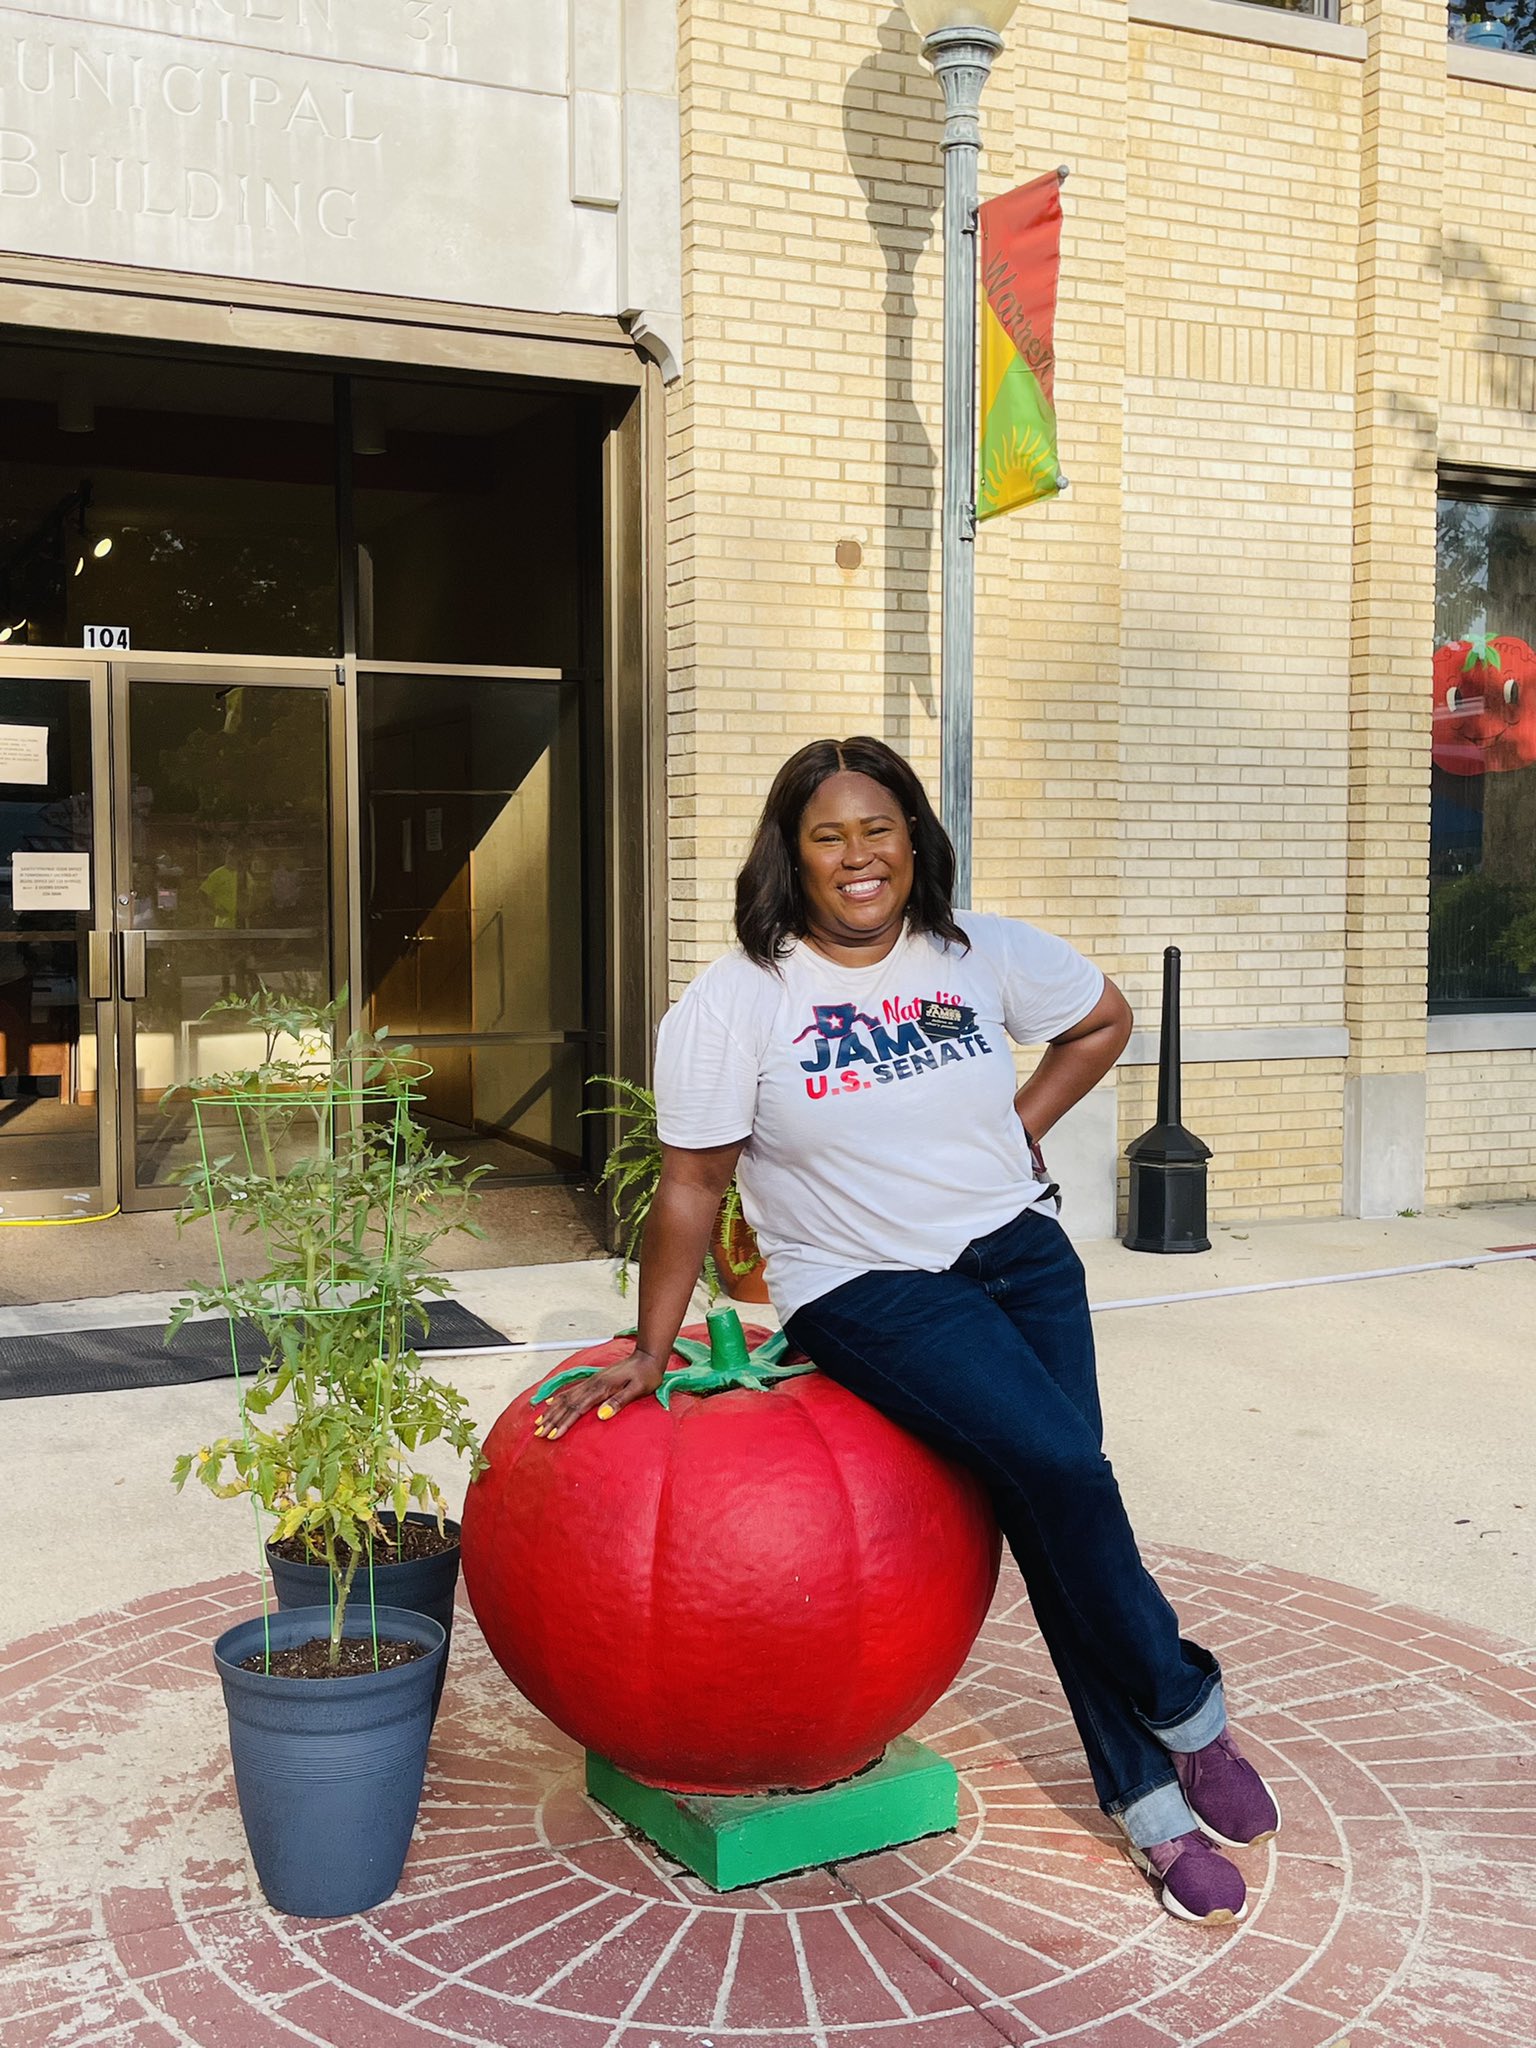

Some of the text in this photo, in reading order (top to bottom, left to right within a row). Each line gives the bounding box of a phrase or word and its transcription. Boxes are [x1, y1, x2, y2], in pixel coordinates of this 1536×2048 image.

[0, 36, 384, 145] UNICIPAL
[0, 129, 359, 240] BUILDING
[985, 250, 1054, 386] Warren
[87, 626, 128, 650] 104
[882, 991, 962, 1025] Natlie
[800, 1020, 979, 1073] JAM
[806, 1033, 993, 1100] U.S. SENATE
